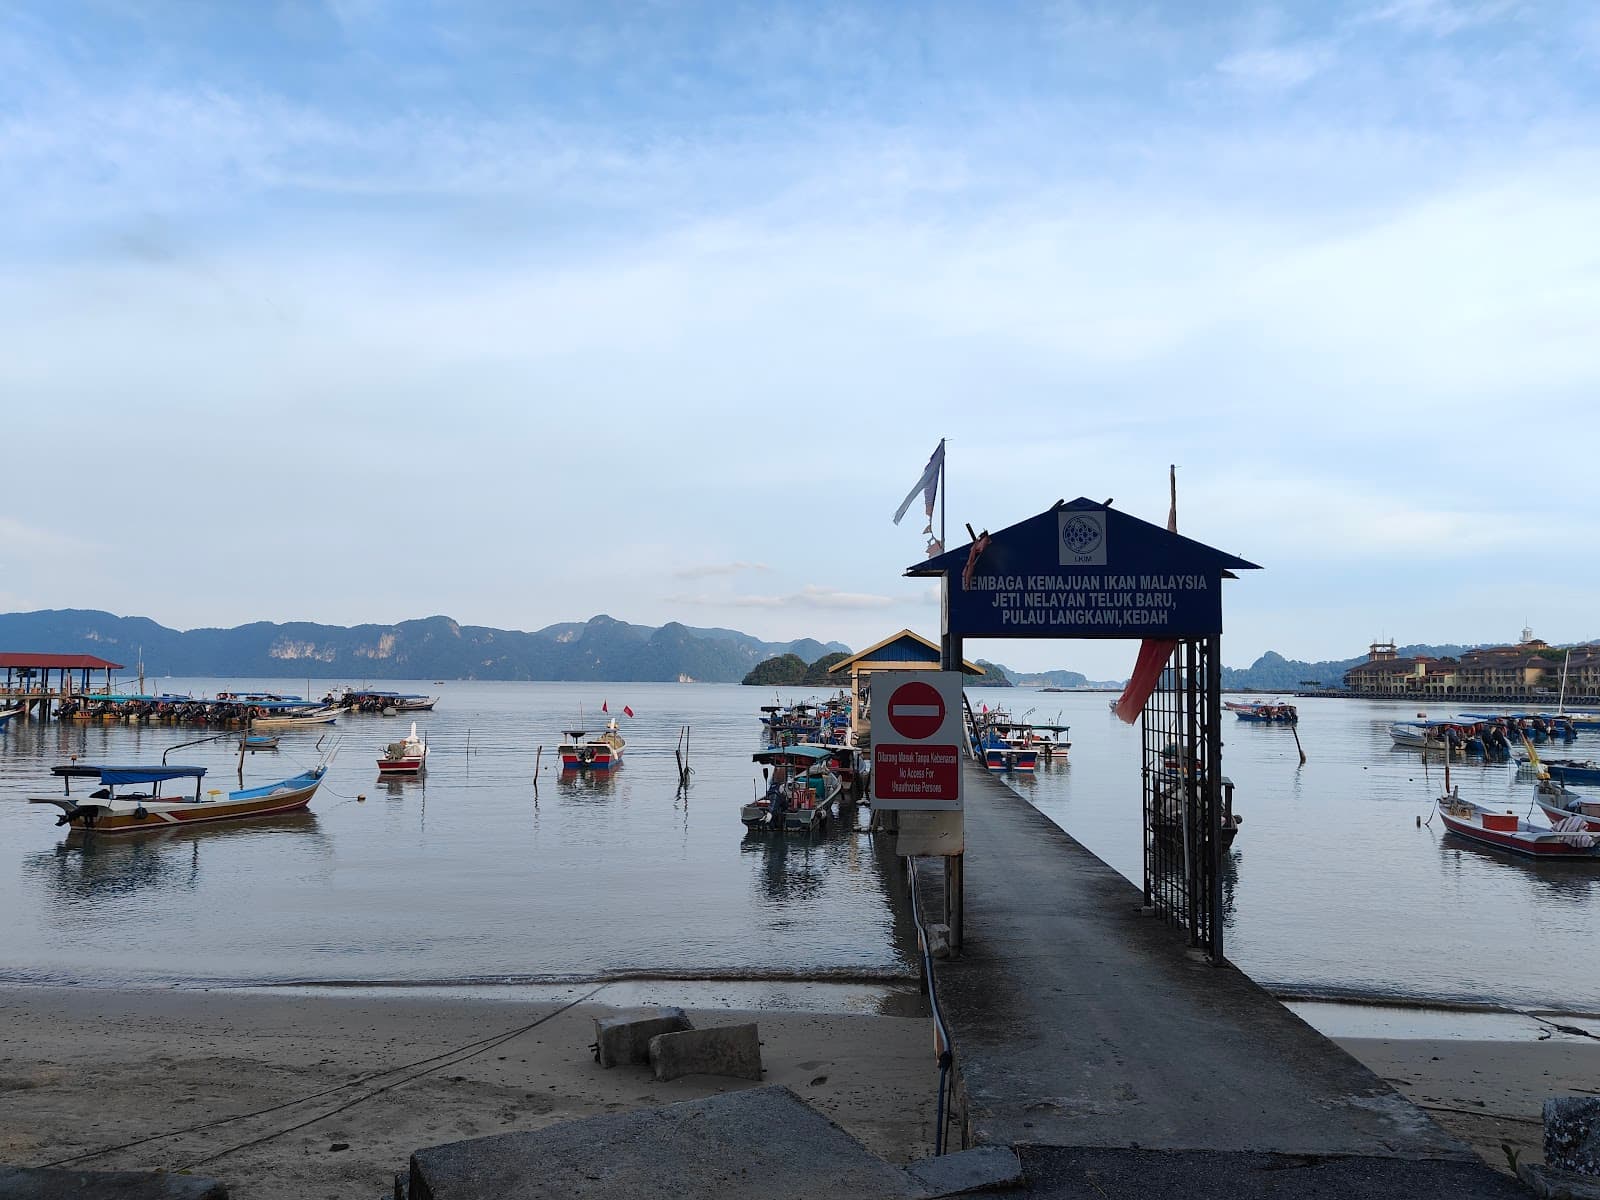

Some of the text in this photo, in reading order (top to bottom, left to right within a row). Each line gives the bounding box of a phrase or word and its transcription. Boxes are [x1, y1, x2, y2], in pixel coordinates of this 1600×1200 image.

[1027, 575, 1100, 590] KEMAJUAN
[1104, 575, 1136, 590] IKAN
[1140, 575, 1208, 590] MALAYSIA
[991, 592, 1177, 610] JETI NELAYAN TELUK BARU,
[1002, 609, 1046, 625] PULAU
[877, 751, 957, 766] Dilarang Masuk Tanpa Kebenaran
[899, 768, 935, 779] No Access For
[921, 782, 942, 793] Persons
